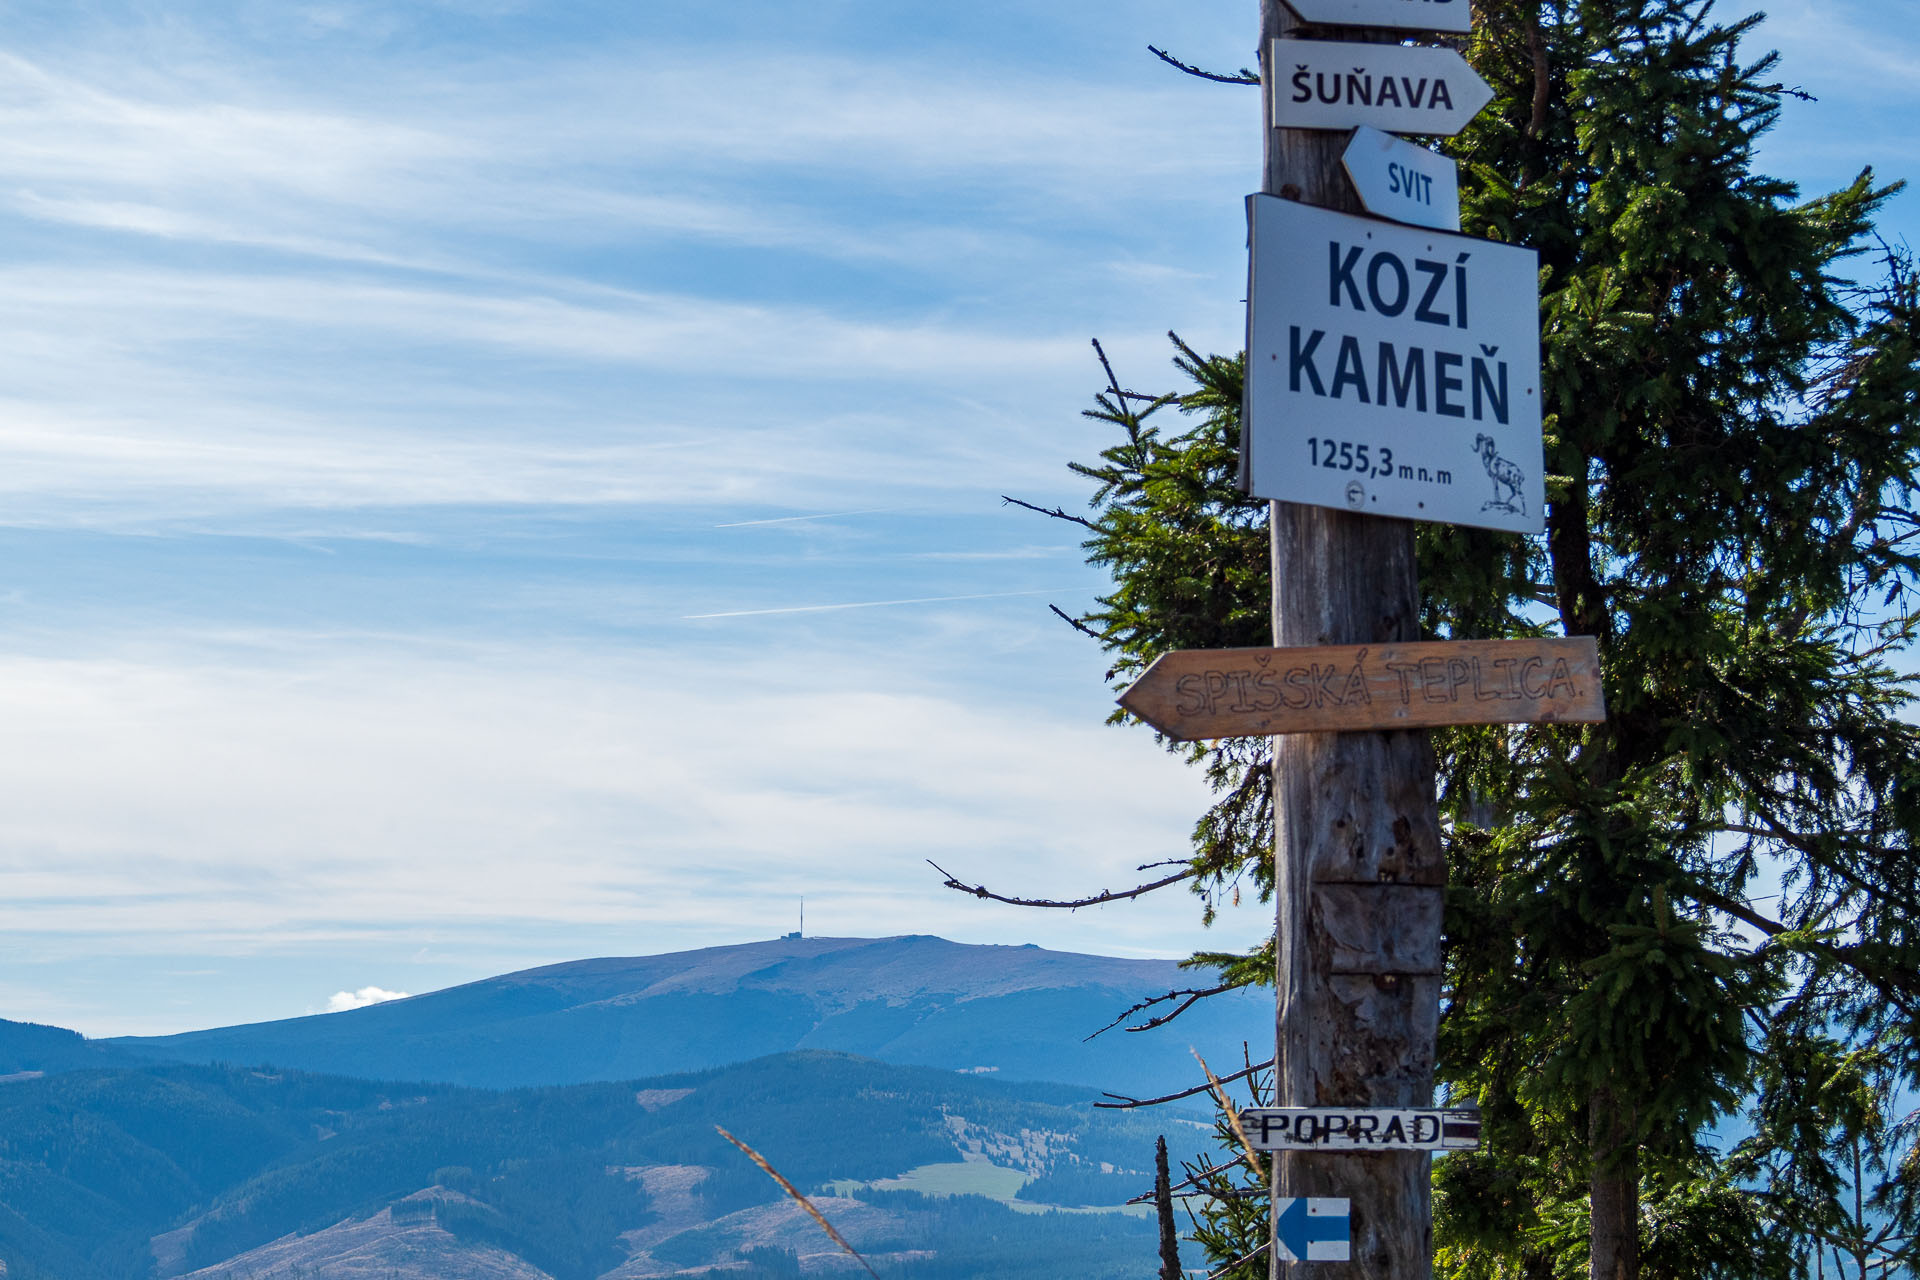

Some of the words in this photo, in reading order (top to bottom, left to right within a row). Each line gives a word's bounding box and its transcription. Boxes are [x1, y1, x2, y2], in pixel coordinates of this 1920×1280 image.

[1291, 64, 1454, 110] ŠUŇAVA
[1388, 162, 1432, 205] SVIT
[1329, 240, 1472, 330] KOZÍ
[1289, 325, 1509, 425] KAMEŇ
[1307, 437, 1394, 479] 1255,3
[1176, 648, 1371, 717] SPIŠSKÁ
[1261, 1115, 1441, 1144] POPRAD
